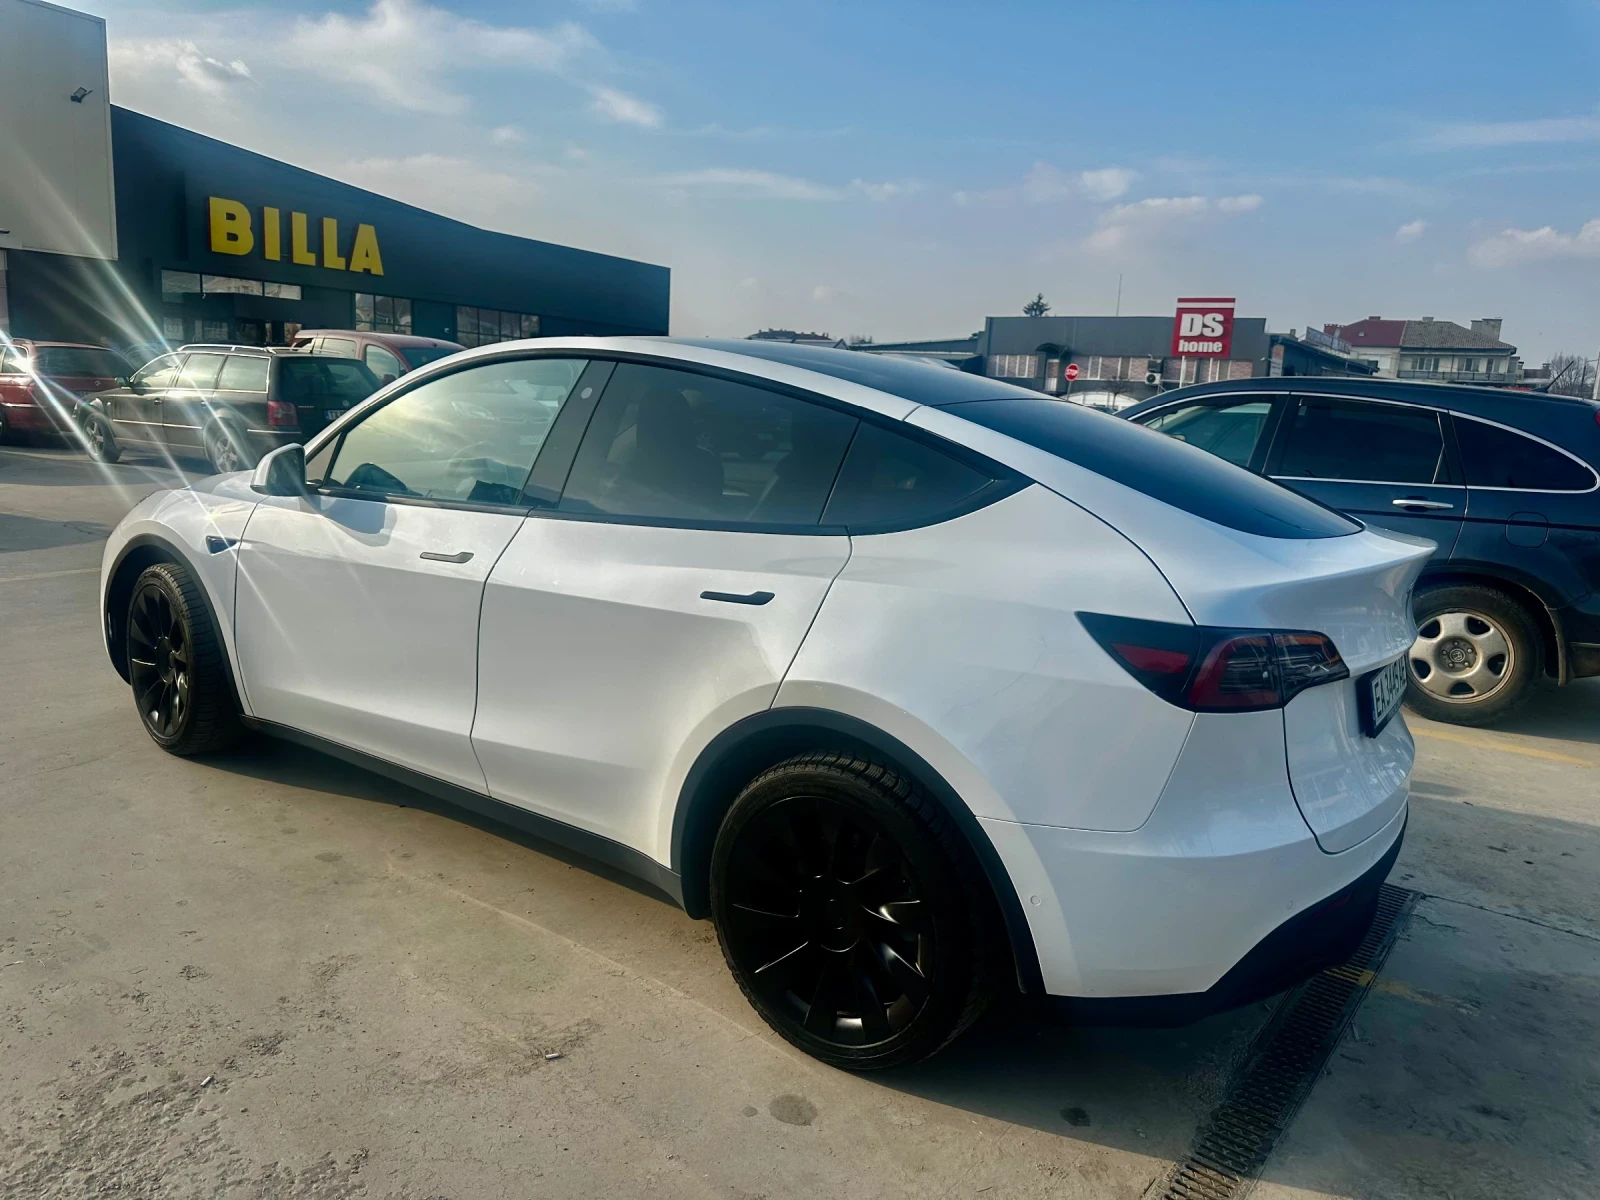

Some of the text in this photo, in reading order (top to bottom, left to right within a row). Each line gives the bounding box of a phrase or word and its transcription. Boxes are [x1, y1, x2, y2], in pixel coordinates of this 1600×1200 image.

[209, 196, 384, 276] BILLA
[1179, 313, 1224, 337] DS
[1178, 339, 1223, 352] home
